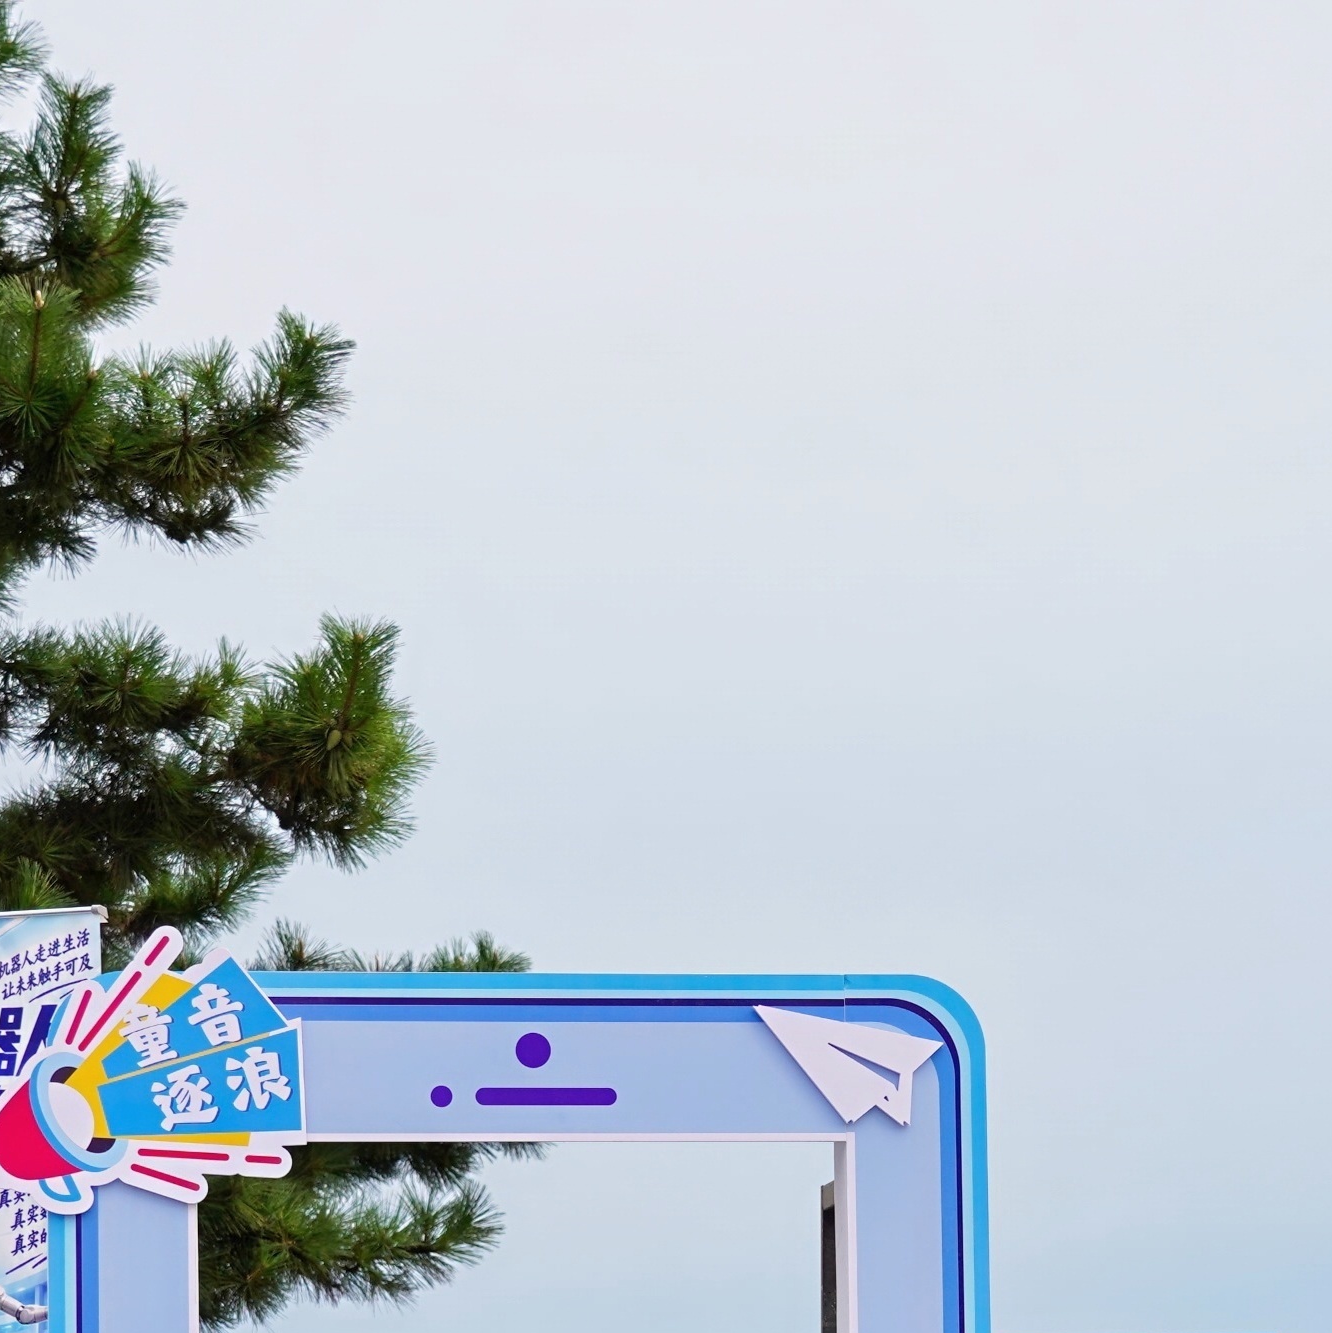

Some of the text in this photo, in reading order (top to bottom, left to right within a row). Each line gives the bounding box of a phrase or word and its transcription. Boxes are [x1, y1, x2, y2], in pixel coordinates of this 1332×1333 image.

[1, 953, 94, 1000] 让未来触手可及
[120, 984, 247, 1069] 童音
[152, 1047, 293, 1131] 逐浪
